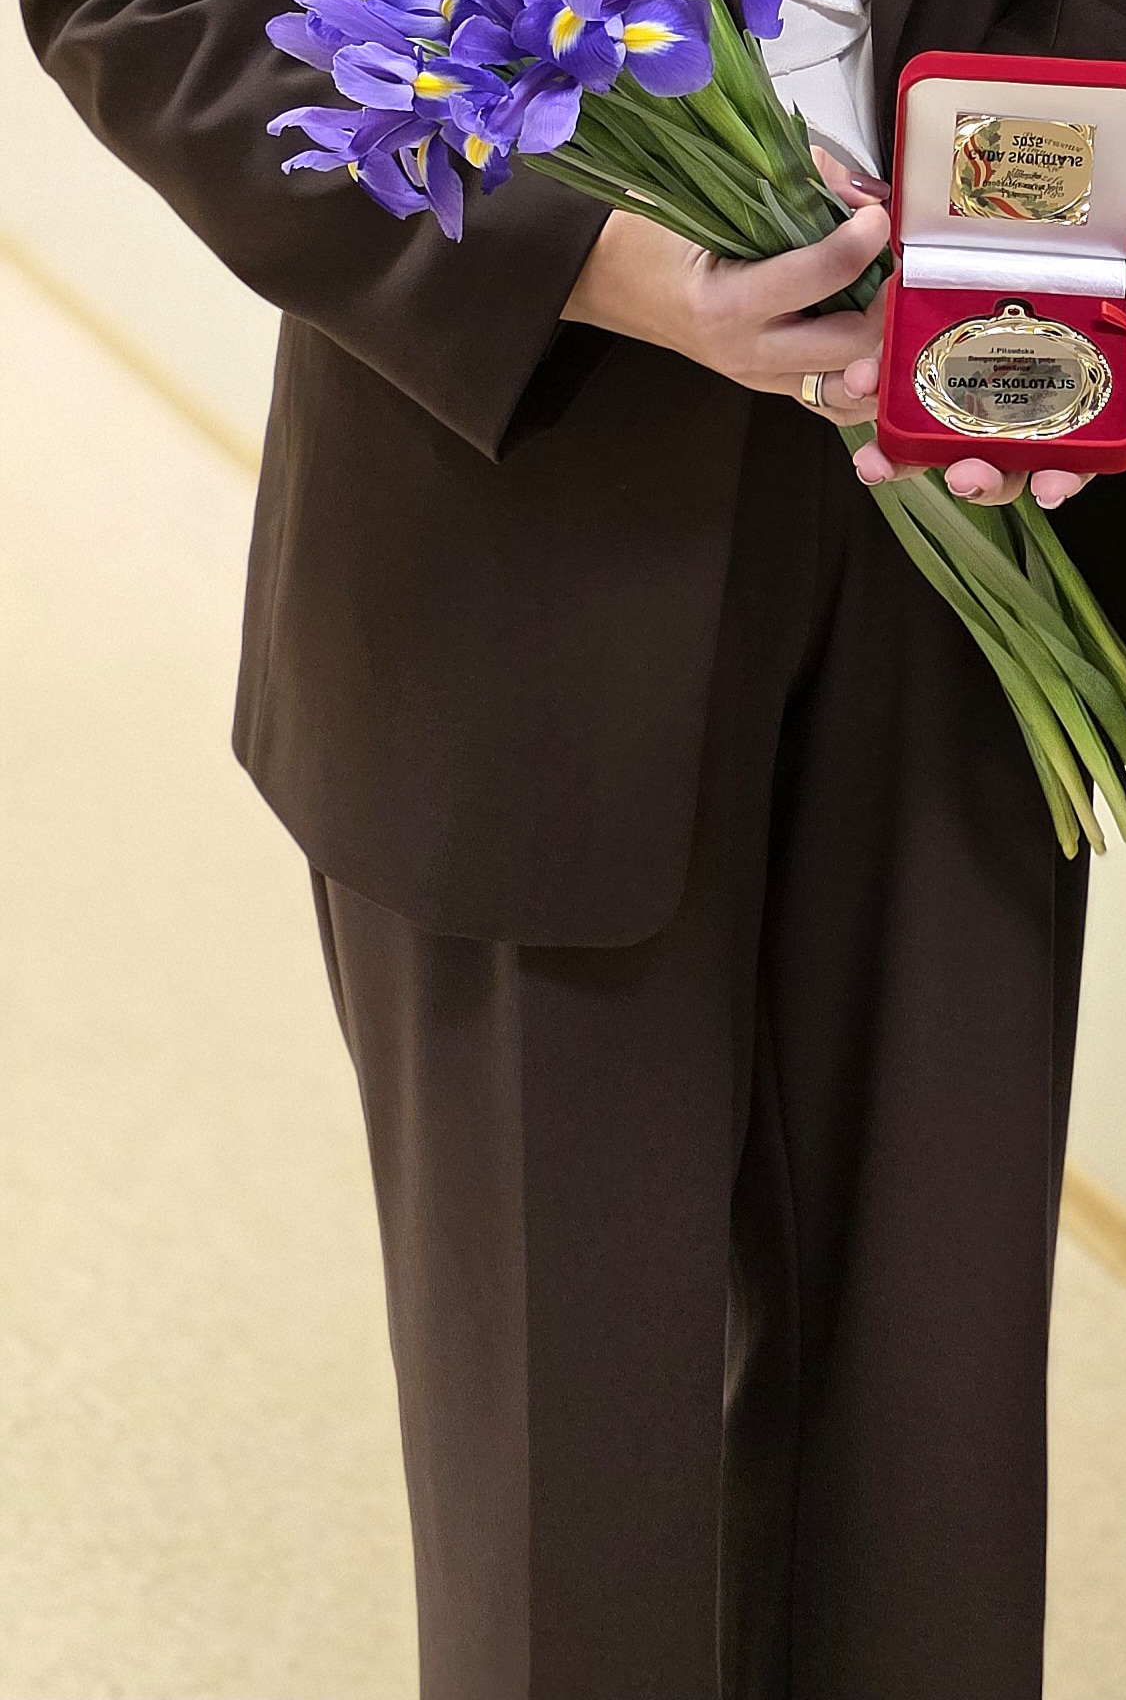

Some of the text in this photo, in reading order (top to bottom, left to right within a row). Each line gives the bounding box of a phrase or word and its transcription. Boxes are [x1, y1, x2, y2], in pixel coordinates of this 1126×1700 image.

[947, 376, 1076, 390] GADA SKOLOTĀJS
[994, 393, 1029, 404] 2025
